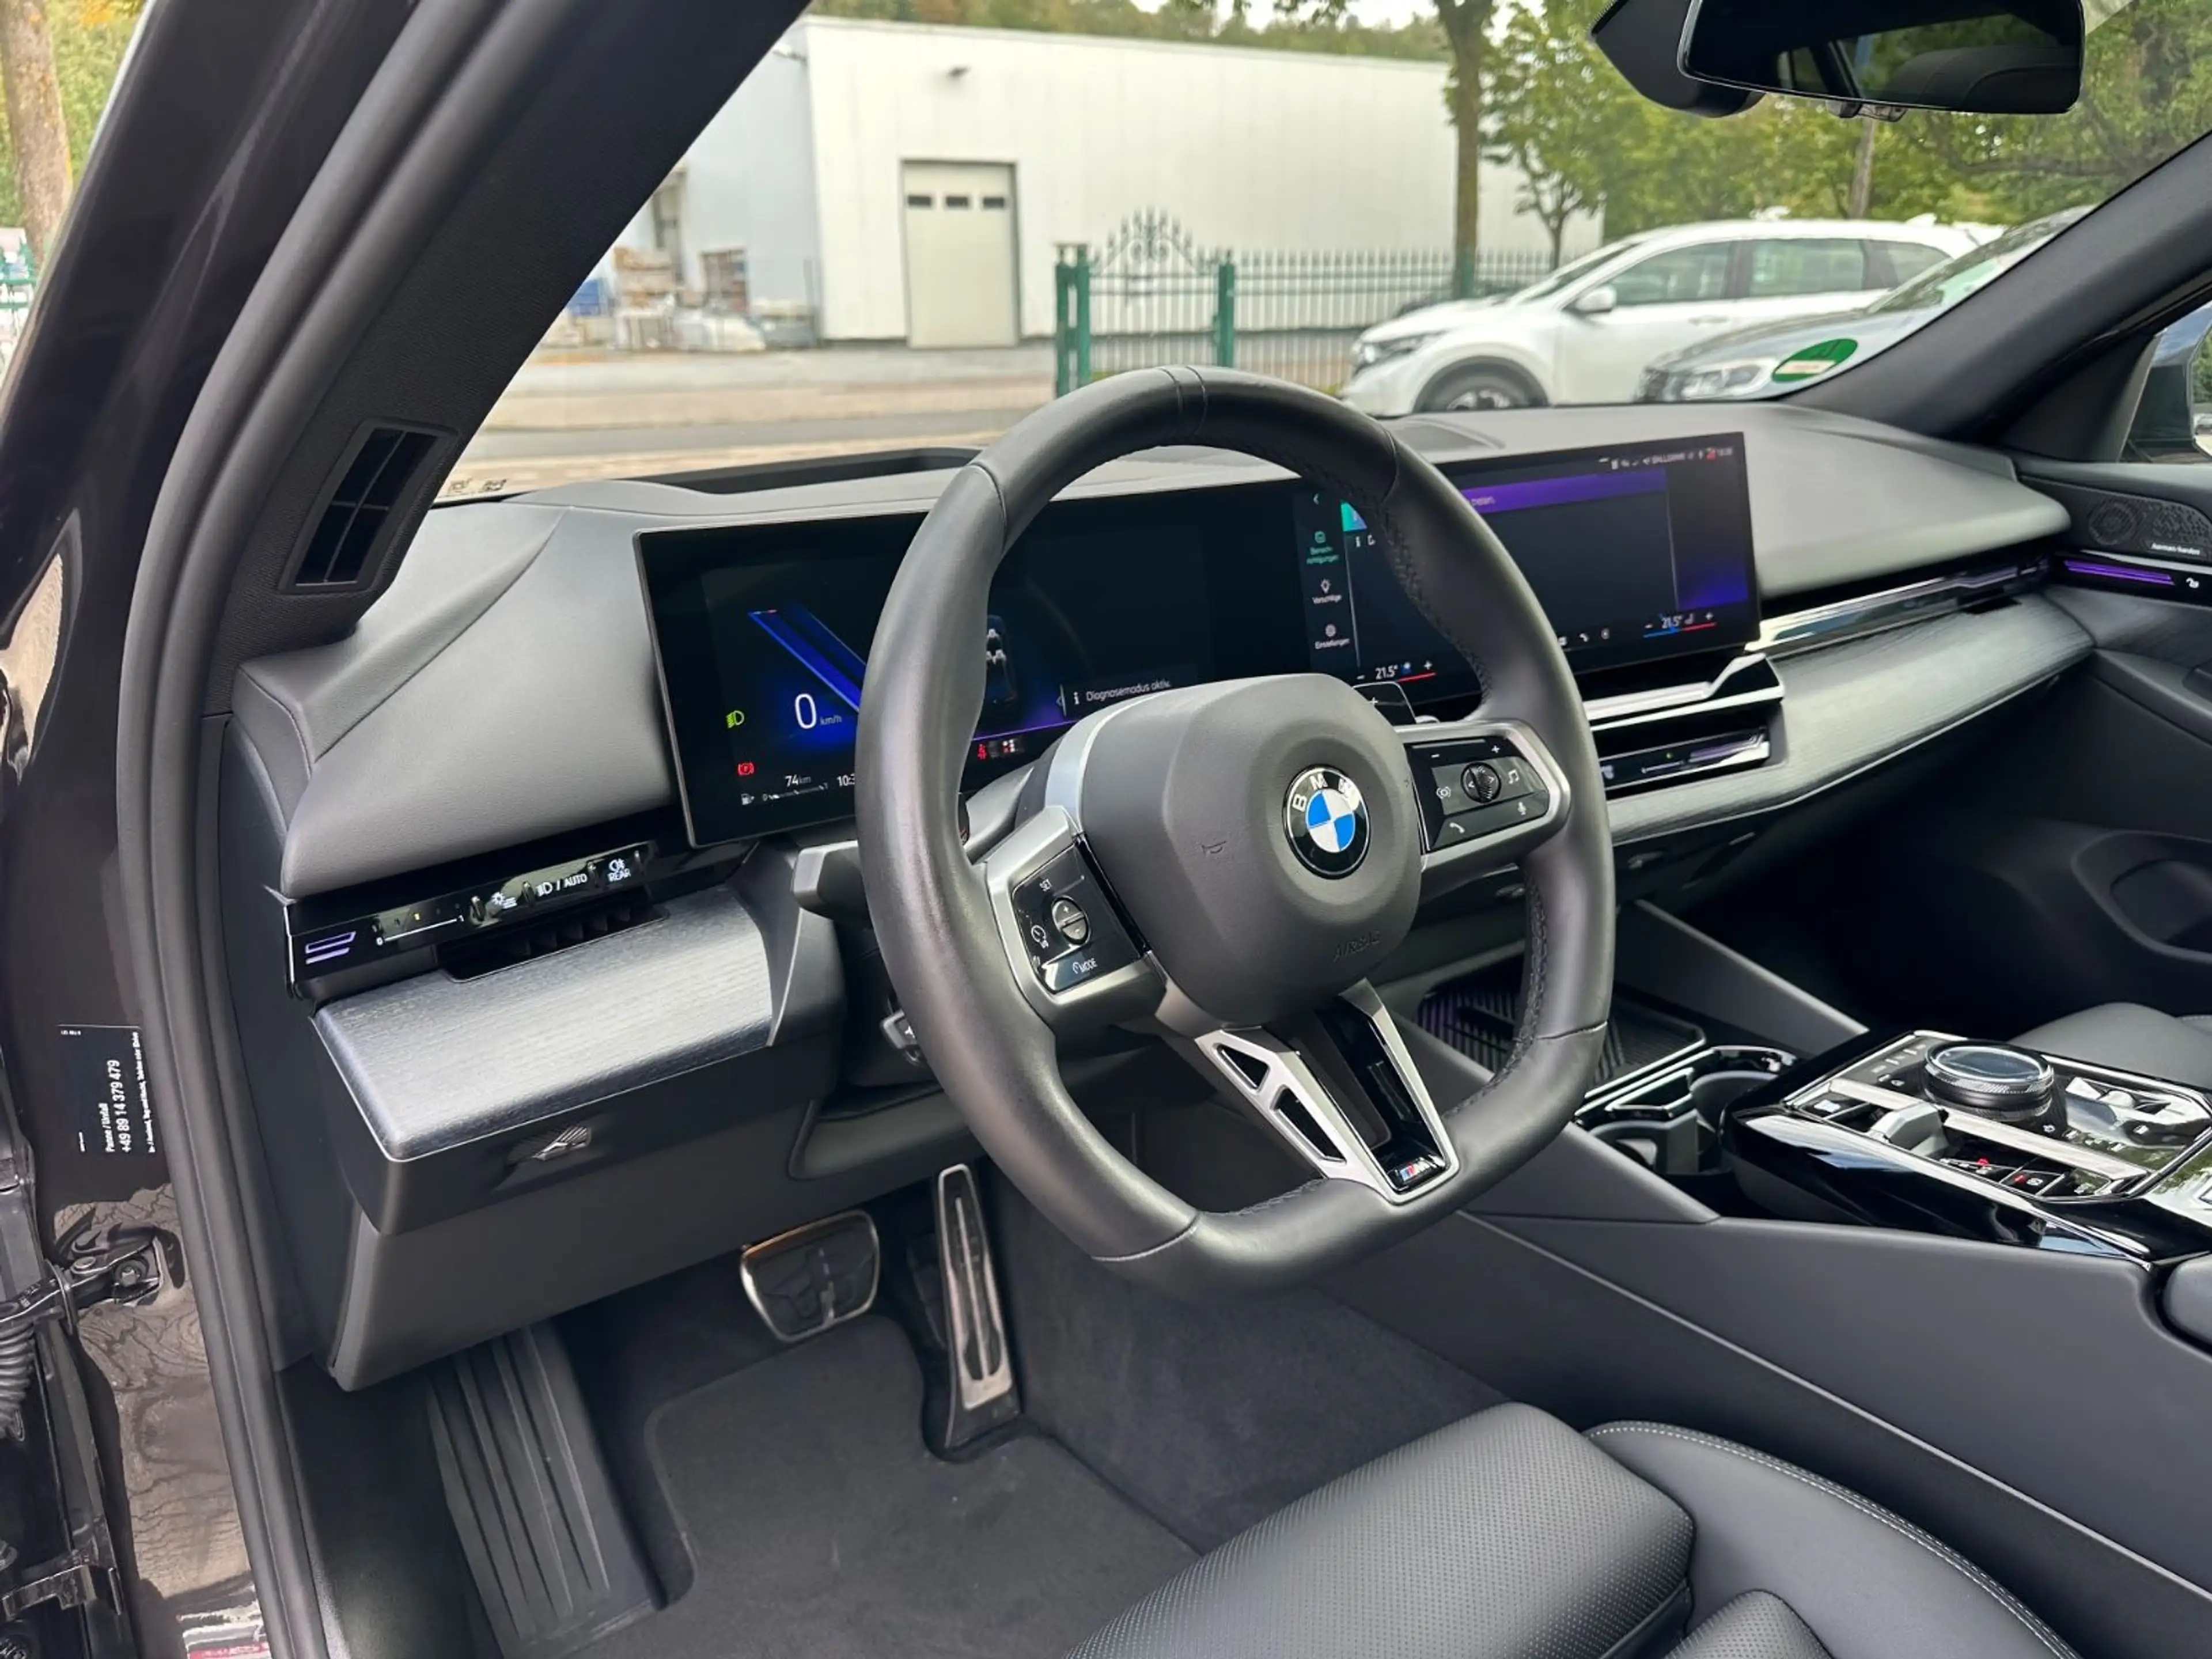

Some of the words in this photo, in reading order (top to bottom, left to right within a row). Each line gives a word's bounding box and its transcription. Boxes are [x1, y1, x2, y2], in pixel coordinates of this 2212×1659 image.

[1086, 683, 1150, 702] Diagnosemodus
[794, 693, 817, 729] 0
[785, 774, 799, 787] 74
[837, 773, 855, 786] 10:3
[564, 873, 588, 888] AUTO
[607, 868, 631, 882] REAR
[1081, 957, 1097, 973] MODE
[107, 1060, 121, 1080] 479
[111, 1081, 126, 1101] 379
[113, 1103, 127, 1116] 14
[116, 1118, 130, 1131] 89
[118, 1132, 131, 1153] +49
